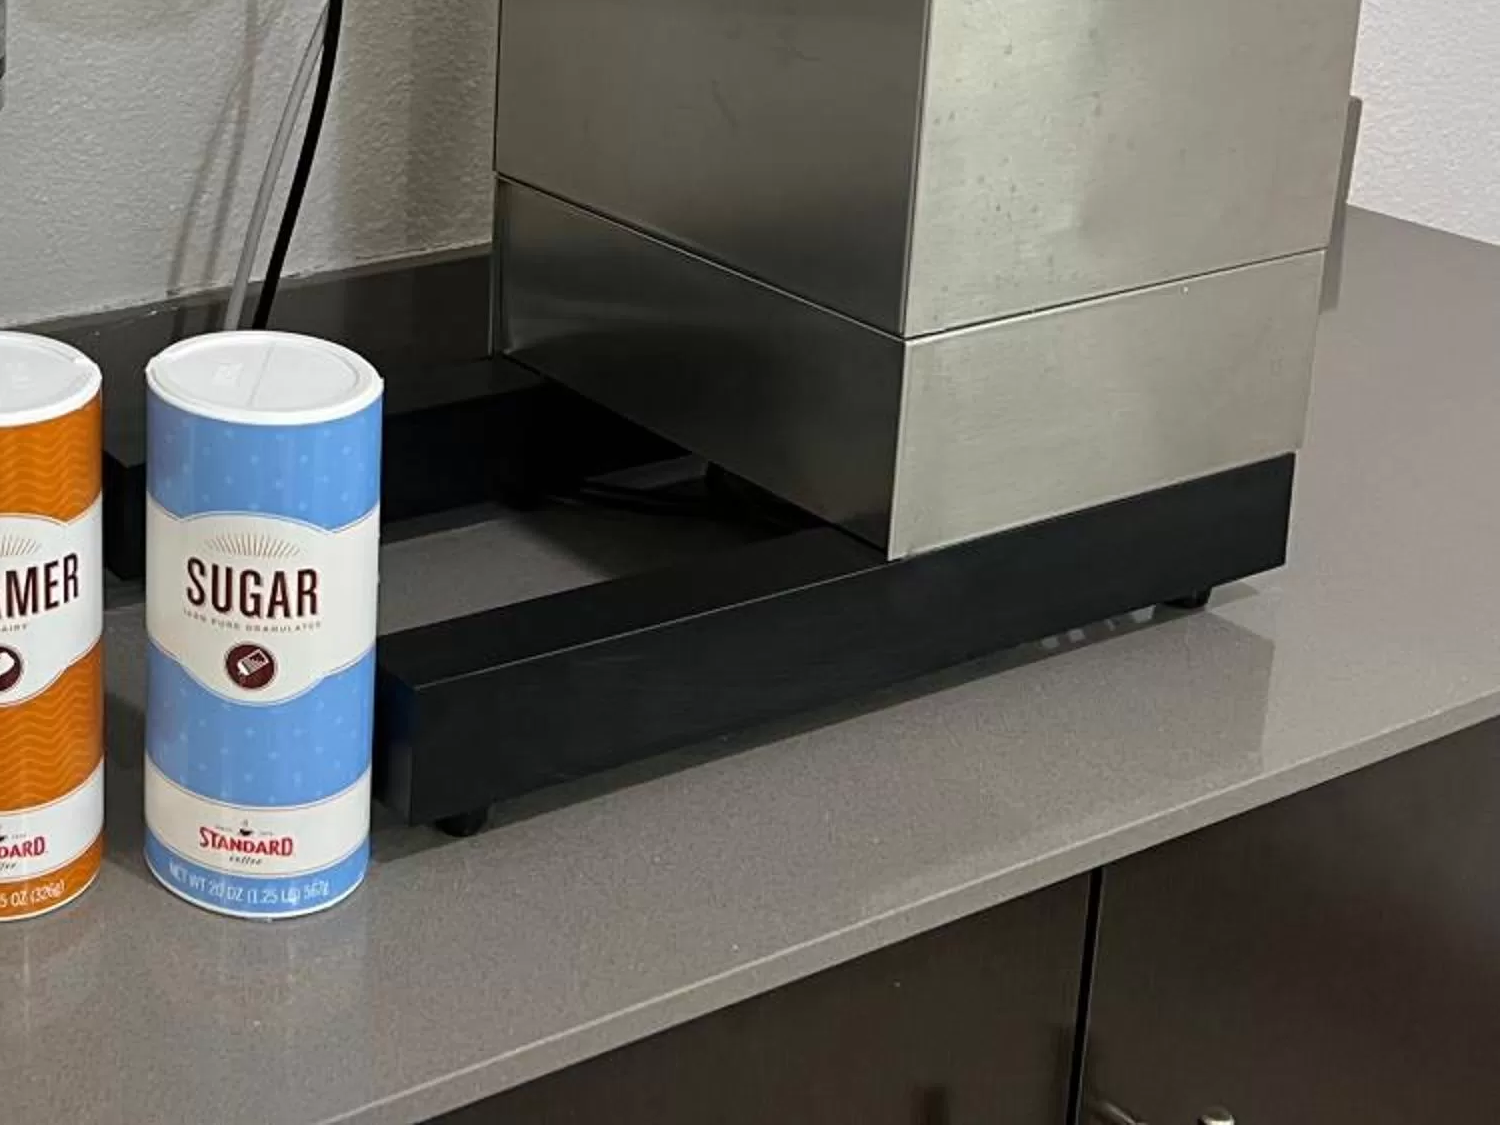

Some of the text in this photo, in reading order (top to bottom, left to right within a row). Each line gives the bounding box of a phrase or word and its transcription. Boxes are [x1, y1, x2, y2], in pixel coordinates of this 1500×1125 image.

[186, 556, 318, 619] SUGAR
[199, 826, 294, 856] STANDARD
[189, 874, 206, 892] WT
[11, 890, 29, 907] OZ
